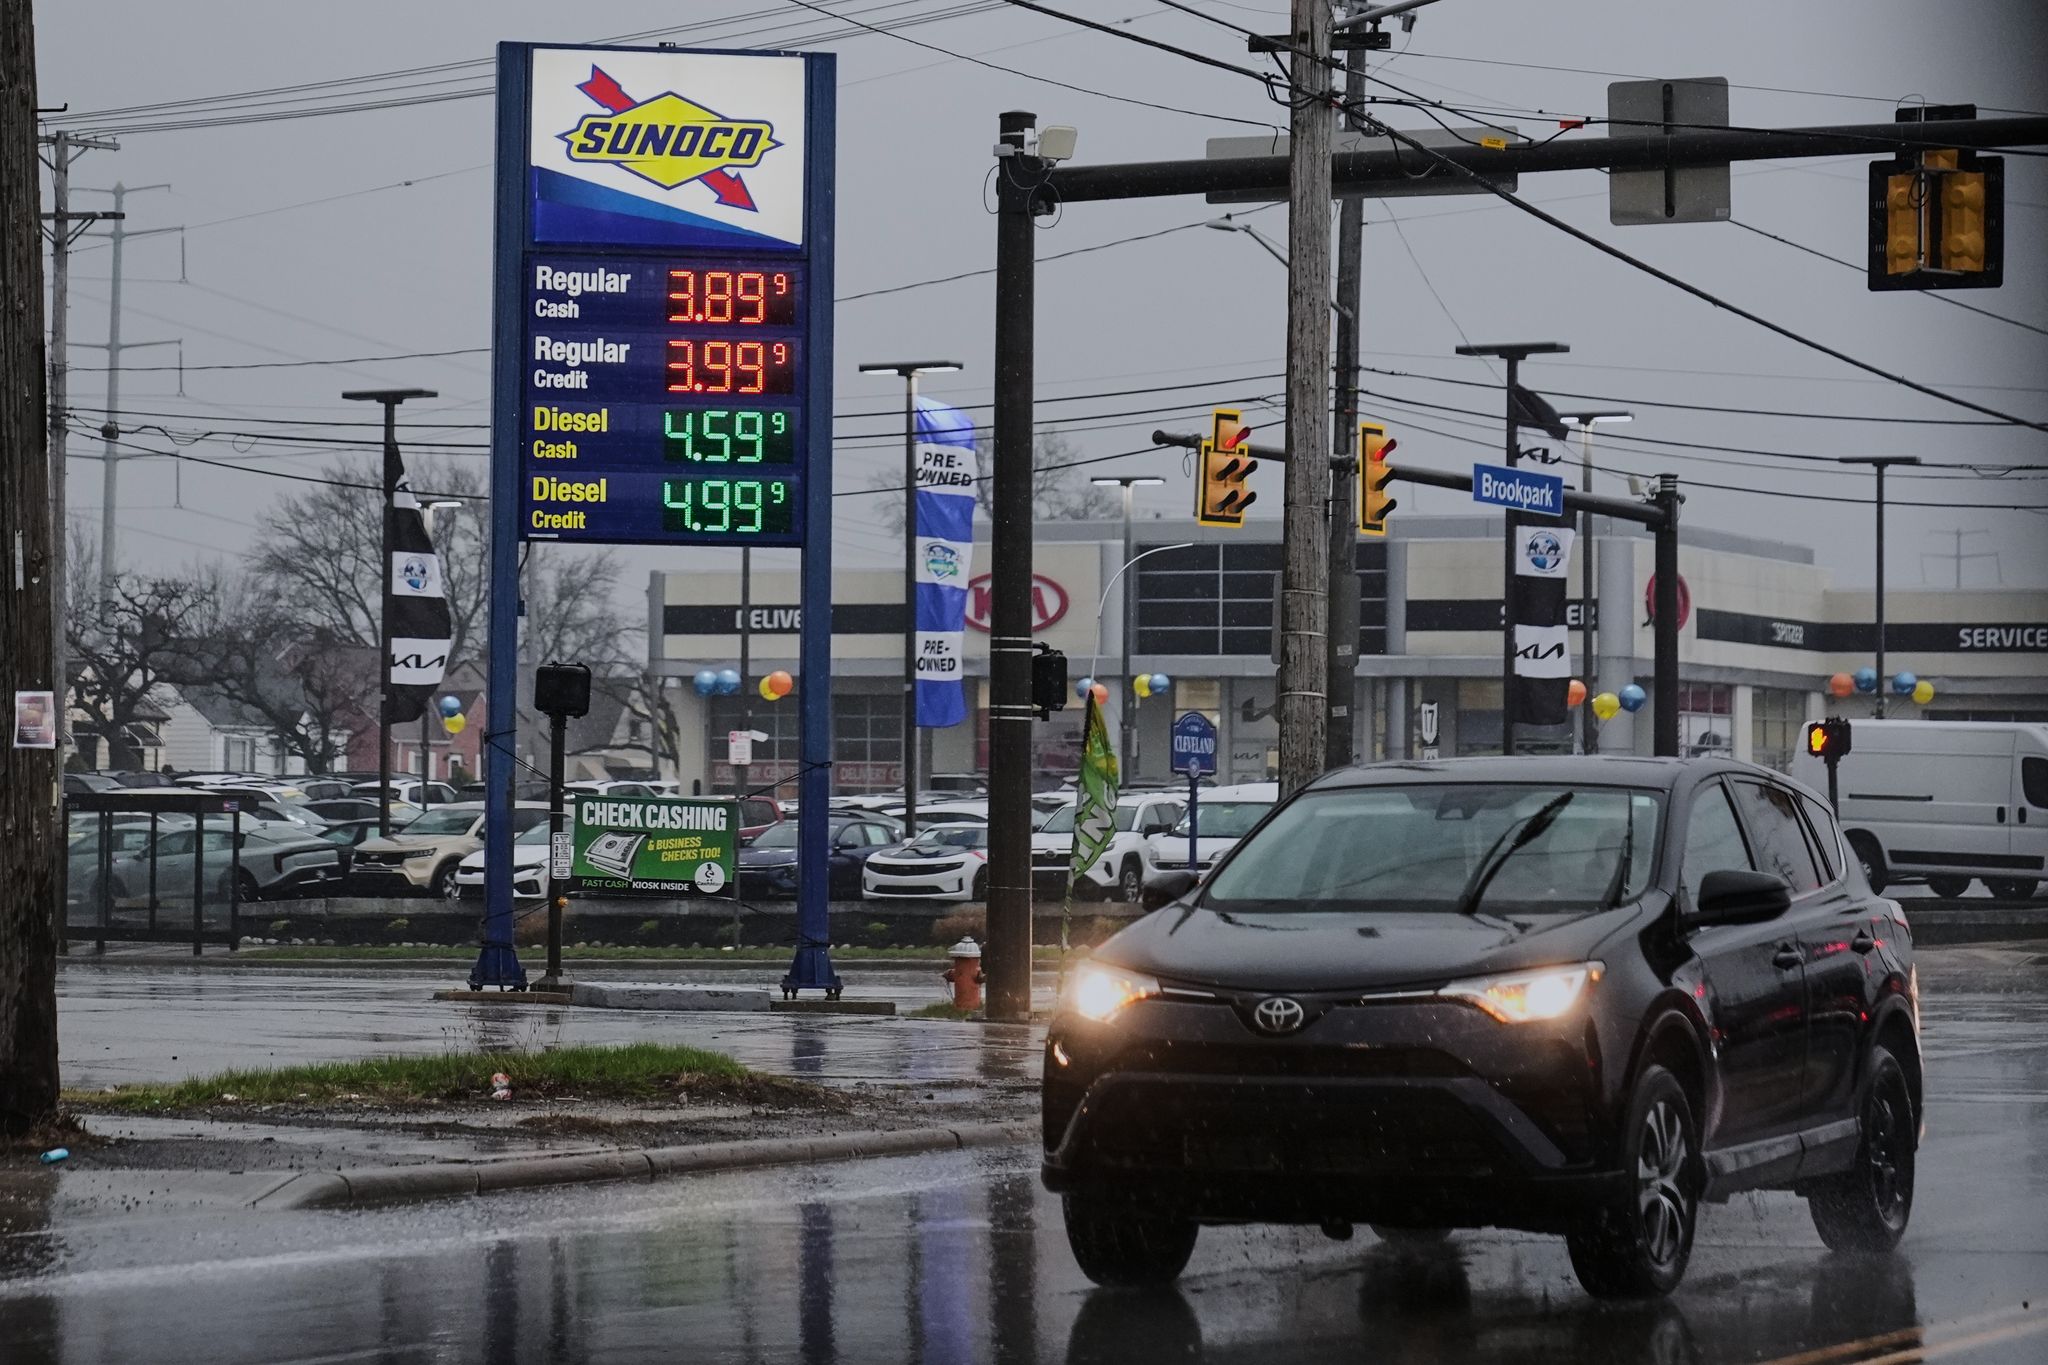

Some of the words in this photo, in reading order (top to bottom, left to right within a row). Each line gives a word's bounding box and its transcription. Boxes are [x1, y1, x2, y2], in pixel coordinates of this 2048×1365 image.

[576, 121, 764, 159] SUNOCO
[535, 265, 632, 296] Regular
[668, 270, 765, 323] 3.89
[534, 299, 580, 319] Cash
[534, 335, 631, 366] Regular
[668, 340, 764, 393] 3.99
[533, 369, 589, 389] Credit
[533, 406, 608, 433] Diesel
[664, 410, 763, 463] 4.59
[532, 440, 577, 459] Cash
[923, 452, 963, 469] PRE-
[916, 467, 973, 488] OWNED
[532, 476, 607, 503] Diesel
[1481, 472, 1554, 509] Brookpark
[663, 480, 763, 533] 4.99
[531, 510, 586, 530] Credit
[974, 586, 1050, 621] KA
[923, 640, 950, 655] PRE-
[1959, 627, 2048, 648] SERVICE
[392, 654, 446, 669] KIA
[917, 656, 956, 672] OWNED
[1174, 735, 1215, 755] CLEVELAND
[582, 801, 643, 828] CHECK
[645, 804, 727, 831] CASHING
[647, 840, 656, 851] &
[656, 837, 702, 850] BUSINESS
[661, 850, 698, 862] CHECKS
[700, 847, 721, 860] TOO!
[582, 879, 602, 888] FAST
[605, 880, 629, 889] CASH
[632, 881, 660, 891] KIOSK
[661, 882, 690, 891] INSIDE
